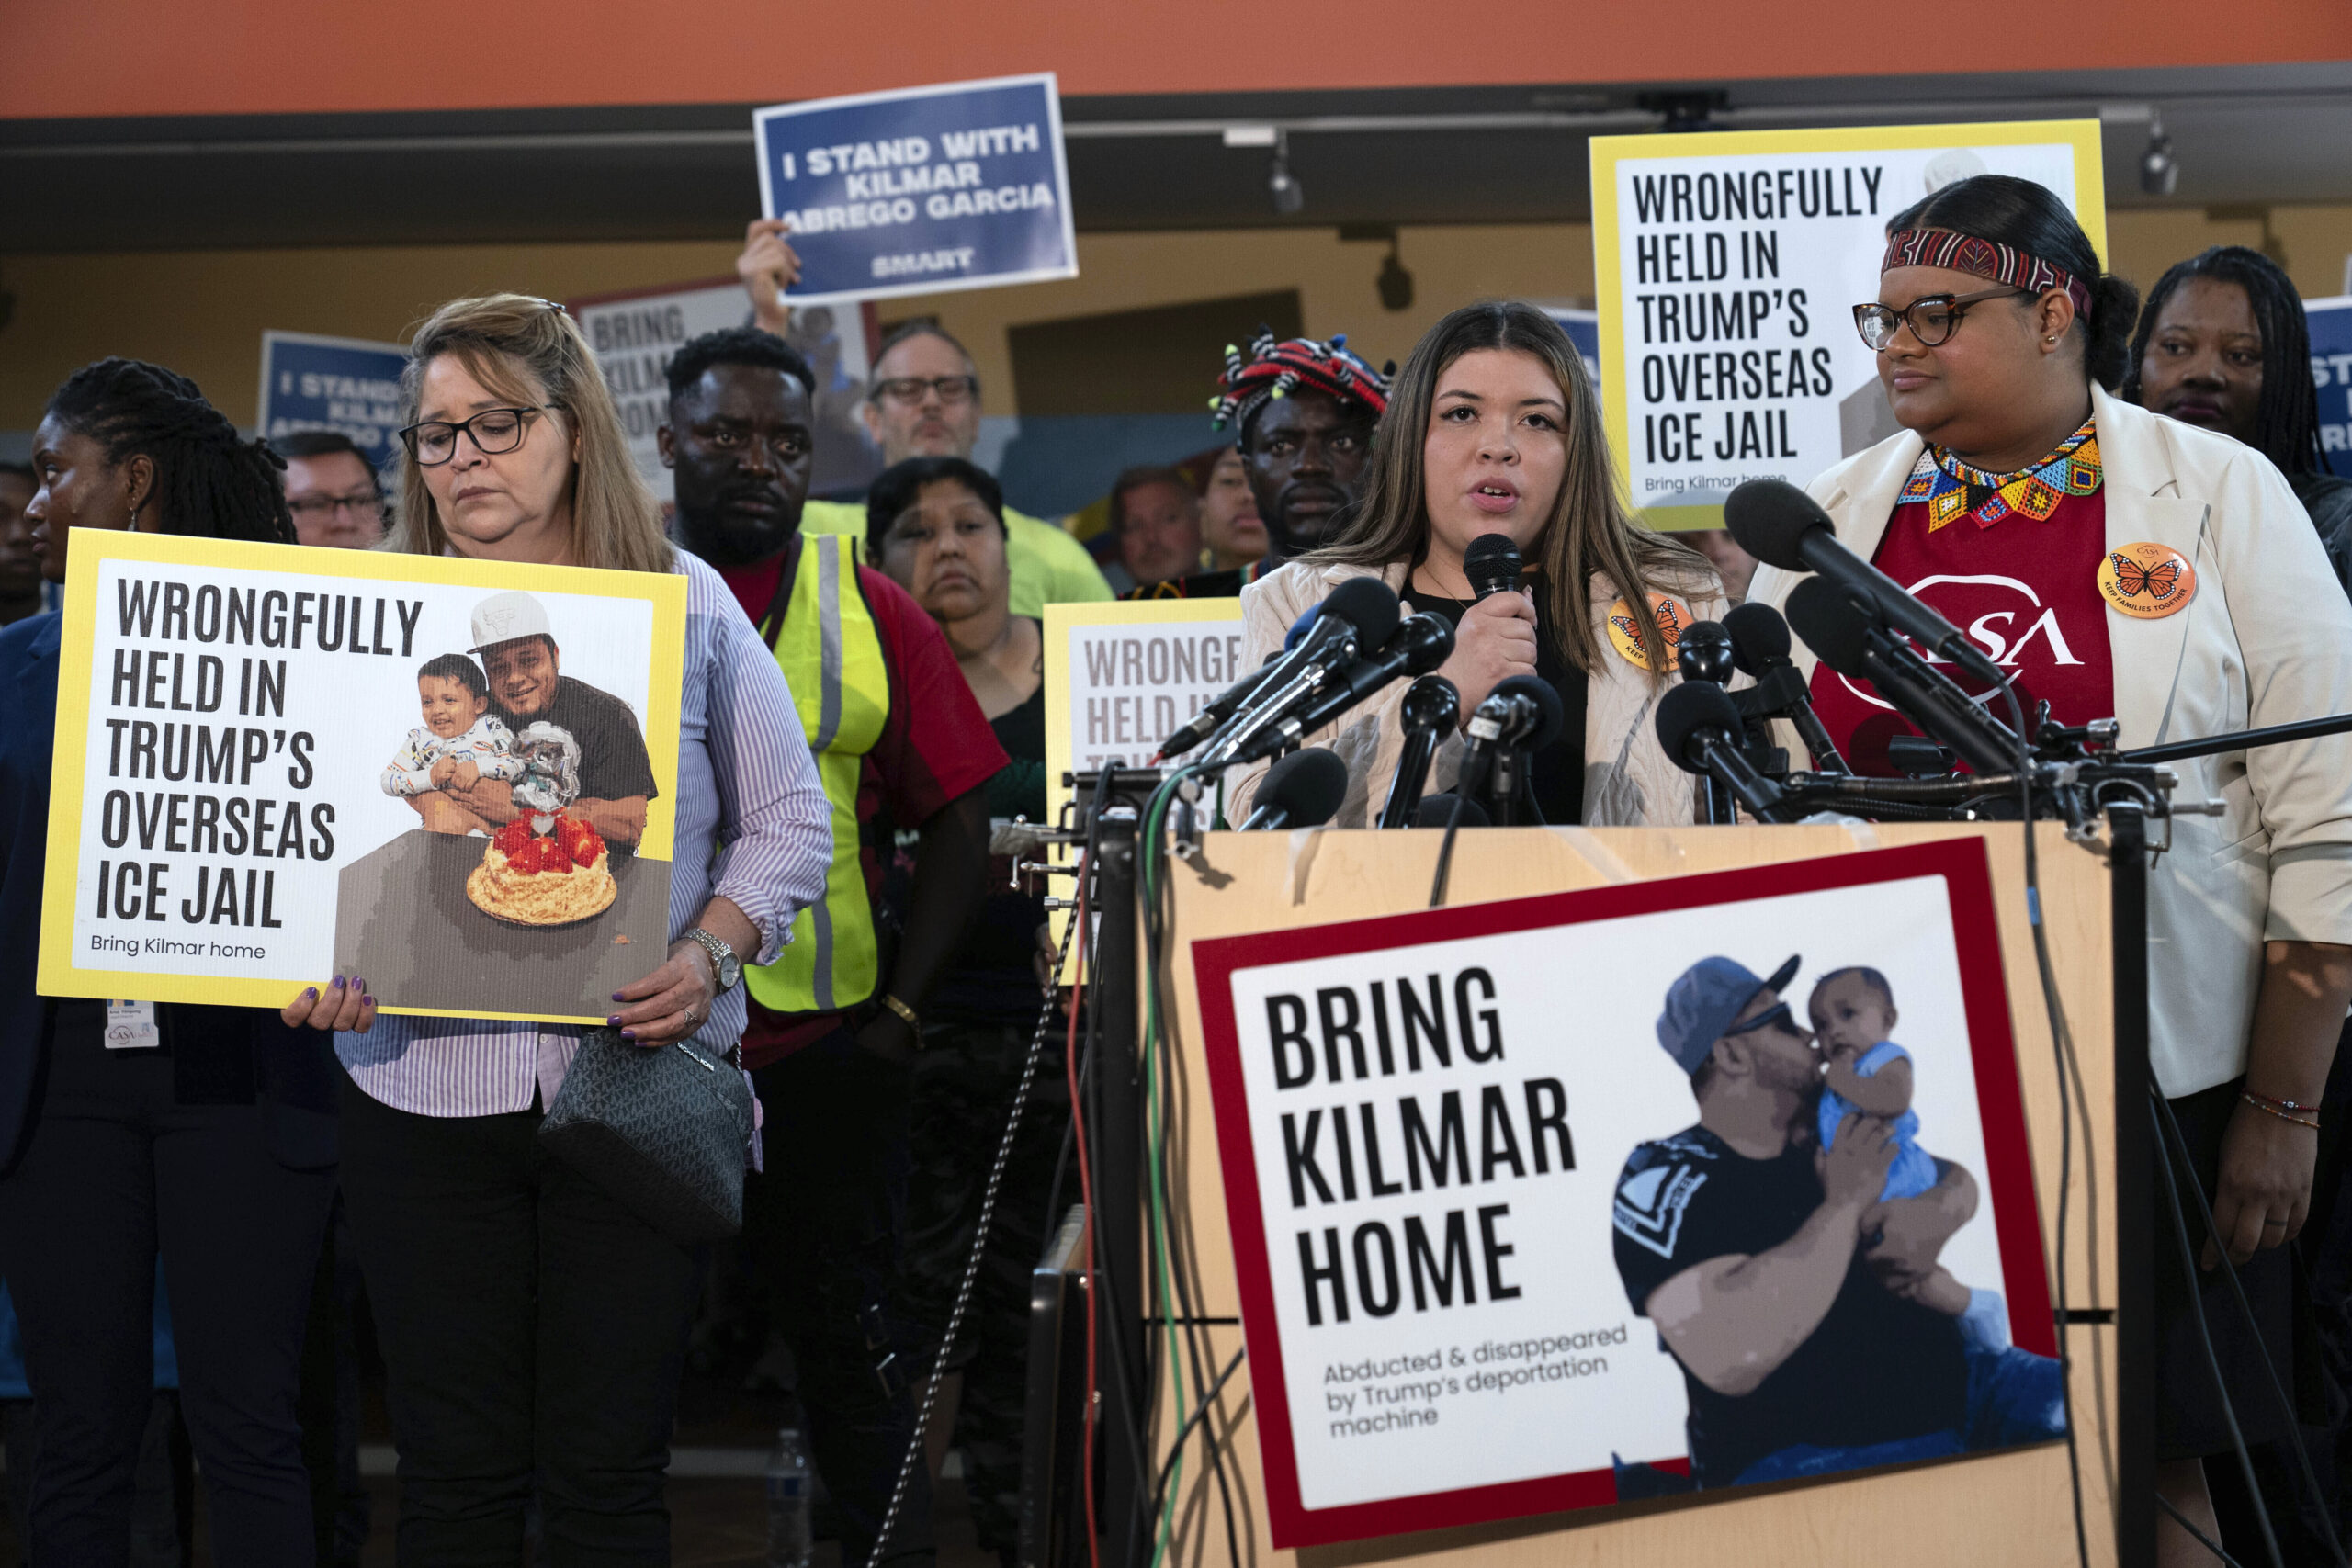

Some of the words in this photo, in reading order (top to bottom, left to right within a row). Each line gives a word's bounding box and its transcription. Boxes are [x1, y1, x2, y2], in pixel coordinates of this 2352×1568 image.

[783, 152, 796, 180] I
[806, 136, 931, 176] STAND
[940, 124, 1039, 160] WITH
[783, 197, 916, 235] ABREGO
[926, 183, 1055, 219] GARCIA
[845, 161, 982, 201] KILMAR
[1633, 166, 1883, 223] WRONGFULLY
[1637, 232, 1727, 284] HELD
[1742, 231, 1779, 279] IN
[594, 304, 684, 352] BRING
[1636, 288, 1809, 344] TRUMP'S
[280, 370, 293, 396] I
[1643, 347, 1833, 403] OVERSEAS
[1645, 412, 1703, 463] ICE
[1715, 409, 1797, 460] JAIL
[1645, 477, 1685, 494] Bring
[1689, 475, 1737, 490] Kilmar
[118, 578, 424, 657] WRONGFULLY
[2104, 581, 2118, 597] KEEP
[2116, 596, 2152, 612] FAMILIES
[2153, 588, 2188, 612] TOGETHER
[1625, 645, 1644, 660] KEEP
[111, 649, 224, 713] HELD
[239, 658, 287, 717] IN
[1087, 694, 1176, 745] HELD
[106, 718, 314, 789] TRUMP'S
[102, 789, 335, 861] OVERSEAS
[96, 860, 169, 921] ICE
[181, 865, 282, 928] JAIL
[91, 935, 139, 956] Bring
[144, 938, 206, 956] Kilmar
[210, 941, 266, 959] home
[1265, 966, 1505, 1090] BRING
[1280, 1077, 1577, 1209] KILMAR
[1296, 1203, 1521, 1327] HOME
[1323, 1349, 1443, 1385] Abducted
[1448, 1346, 1466, 1368] &
[1472, 1323, 1628, 1364] disappeared
[1326, 1392, 1357, 1416] by
[1363, 1376, 1460, 1407] Trump's
[1465, 1355, 1609, 1393] deportation
[1329, 1406, 1440, 1438] machine
